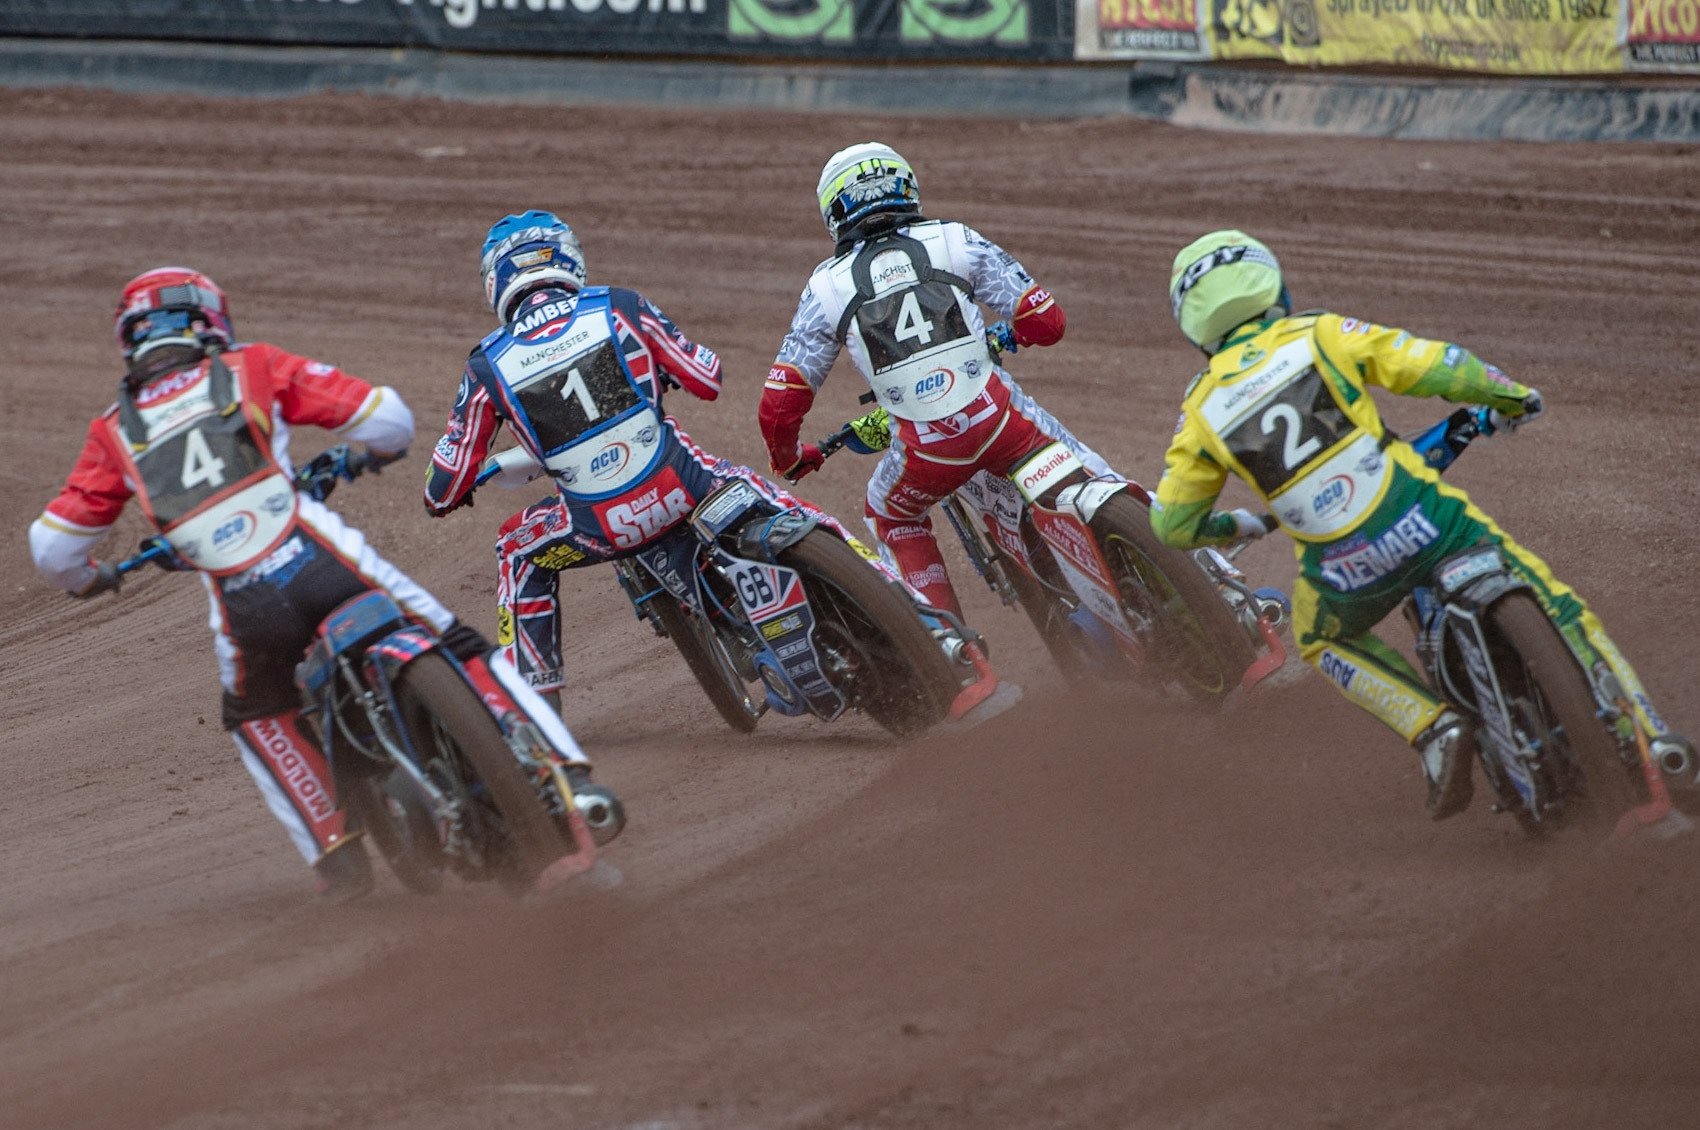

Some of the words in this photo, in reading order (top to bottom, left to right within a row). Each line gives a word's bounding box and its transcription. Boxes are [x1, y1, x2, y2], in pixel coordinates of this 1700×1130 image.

[1505, 1, 1550, 20] since
[893, 291, 934, 345] 4
[520, 331, 590, 368] MANCHESTER
[560, 367, 600, 421] 1
[915, 373, 945, 396] ACU
[1260, 403, 1322, 470] 2
[181, 427, 226, 489] 4
[591, 447, 620, 473] ACU
[1023, 450, 1073, 489] Organika
[630, 487, 659, 513] DAILY
[1313, 480, 1344, 513] ACU
[213, 517, 244, 545] ACU
[606, 487, 694, 548] STAR
[1321, 503, 1440, 592] STEWART
[736, 565, 774, 608] GB
[249, 718, 336, 823] MOLDOW
